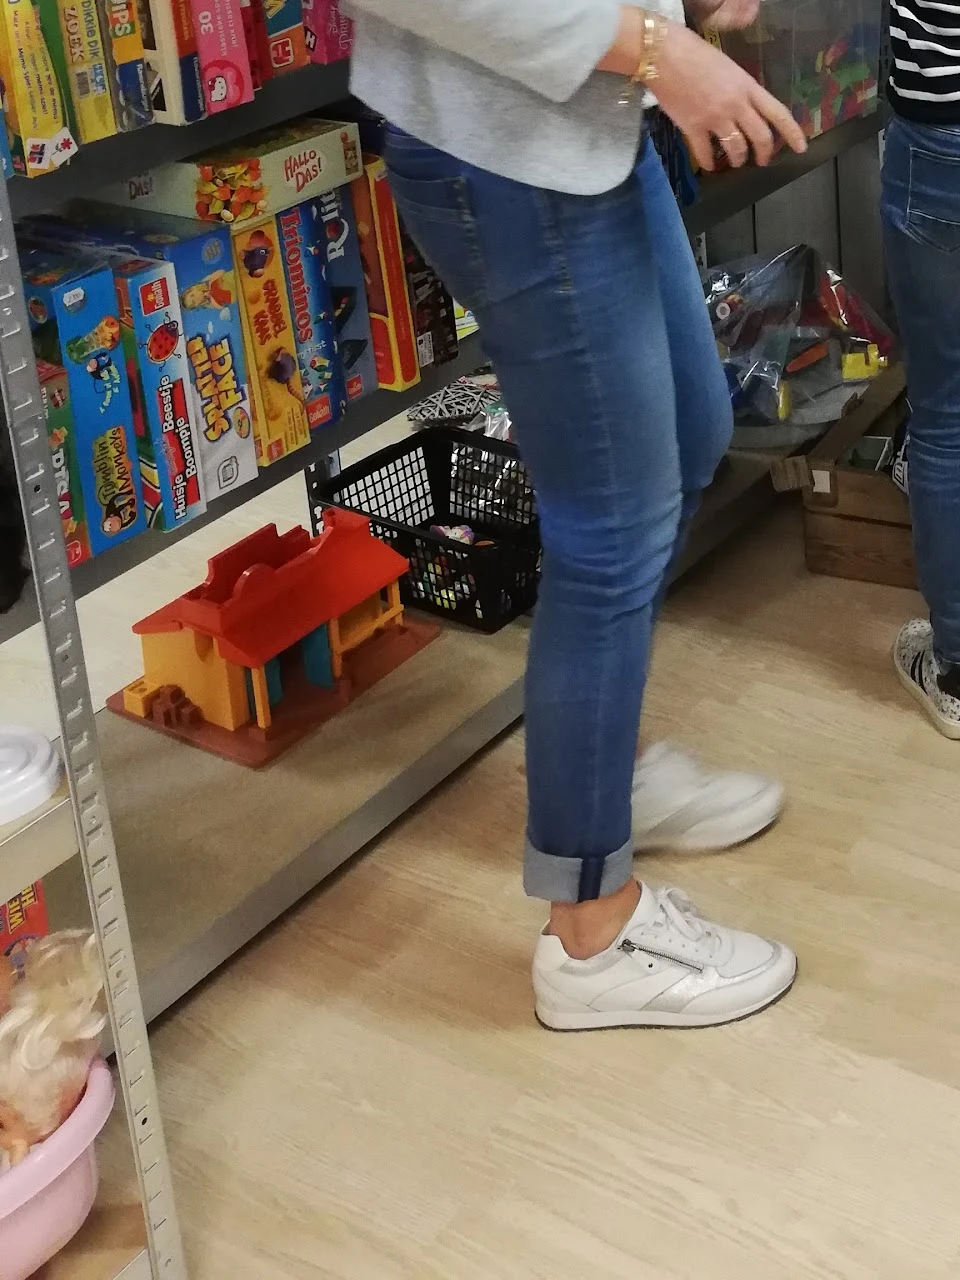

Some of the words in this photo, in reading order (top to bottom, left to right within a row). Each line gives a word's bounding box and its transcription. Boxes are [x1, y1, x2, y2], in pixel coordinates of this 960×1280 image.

[198, 11, 214, 35] 30
[284, 149, 317, 182] HALLO
[295, 157, 323, 193] DAS!
[280, 206, 313, 344] Triominos
[158, 374, 176, 434] Beestje
[186, 334, 232, 443] SPLATTER
[209, 338, 246, 410] FACE
[110, 426, 134, 492] Monkeys
[175, 416, 197, 478] Boompje
[174, 473, 188, 521] Huisje
